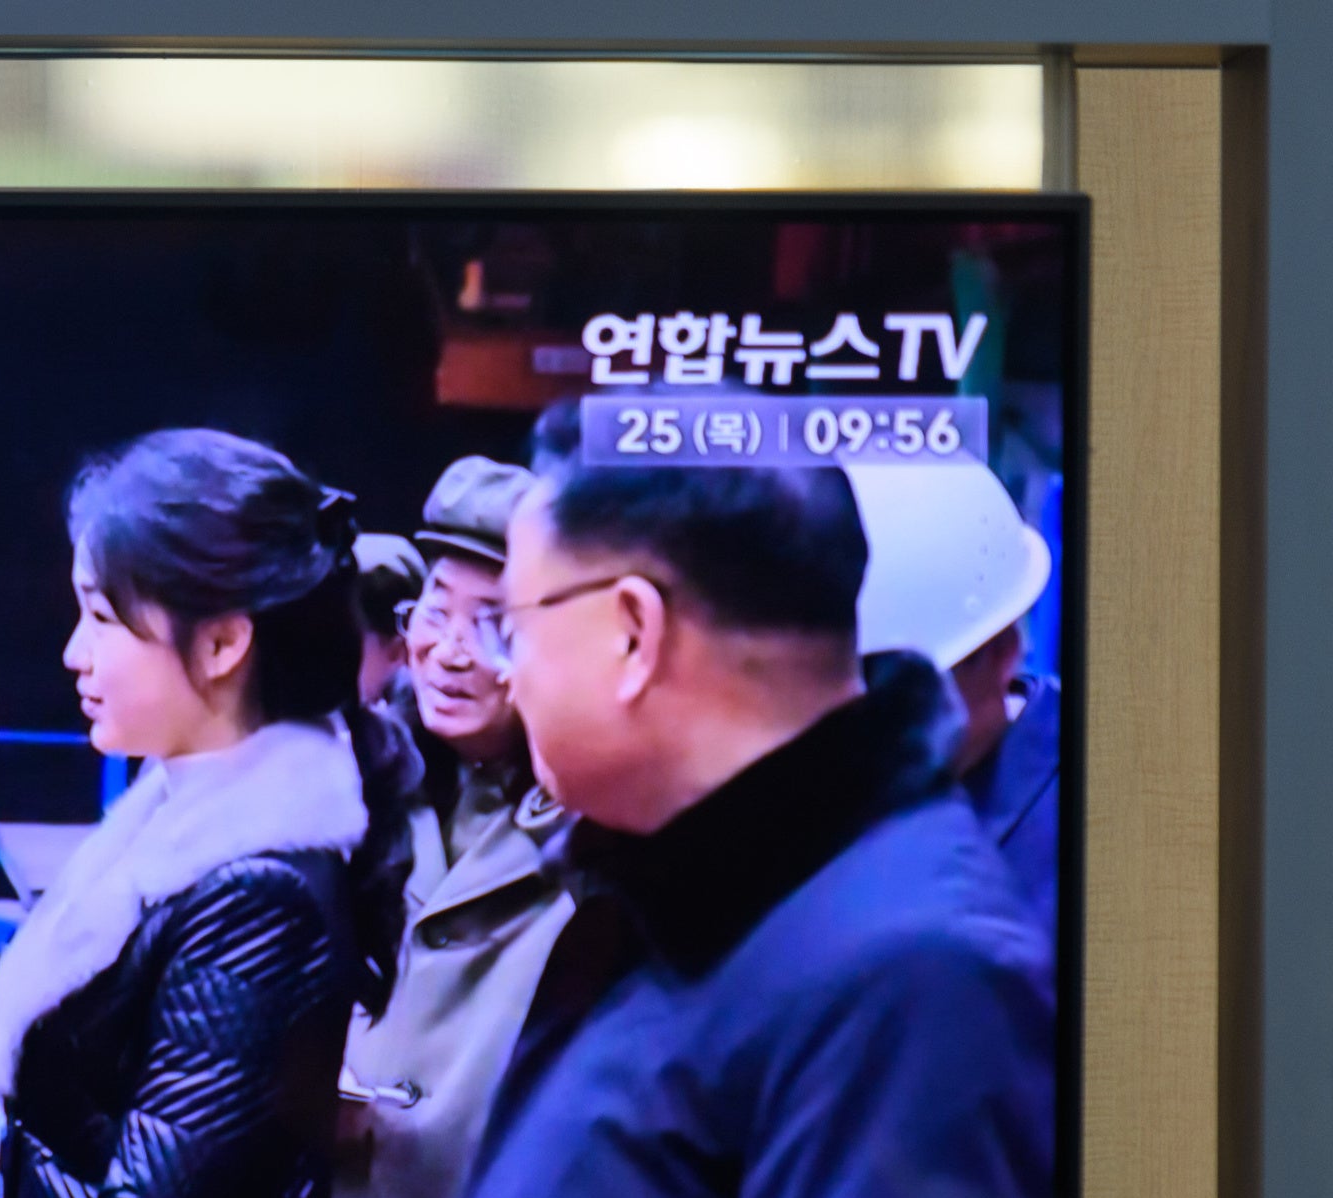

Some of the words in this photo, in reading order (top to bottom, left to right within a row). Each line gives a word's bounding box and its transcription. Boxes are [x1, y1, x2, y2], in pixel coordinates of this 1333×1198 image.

[582, 311, 988, 386] 연합뉴스TV
[616, 408, 683, 454] 25
[693, 408, 763, 456] (목)
[804, 408, 961, 455] 09:56
